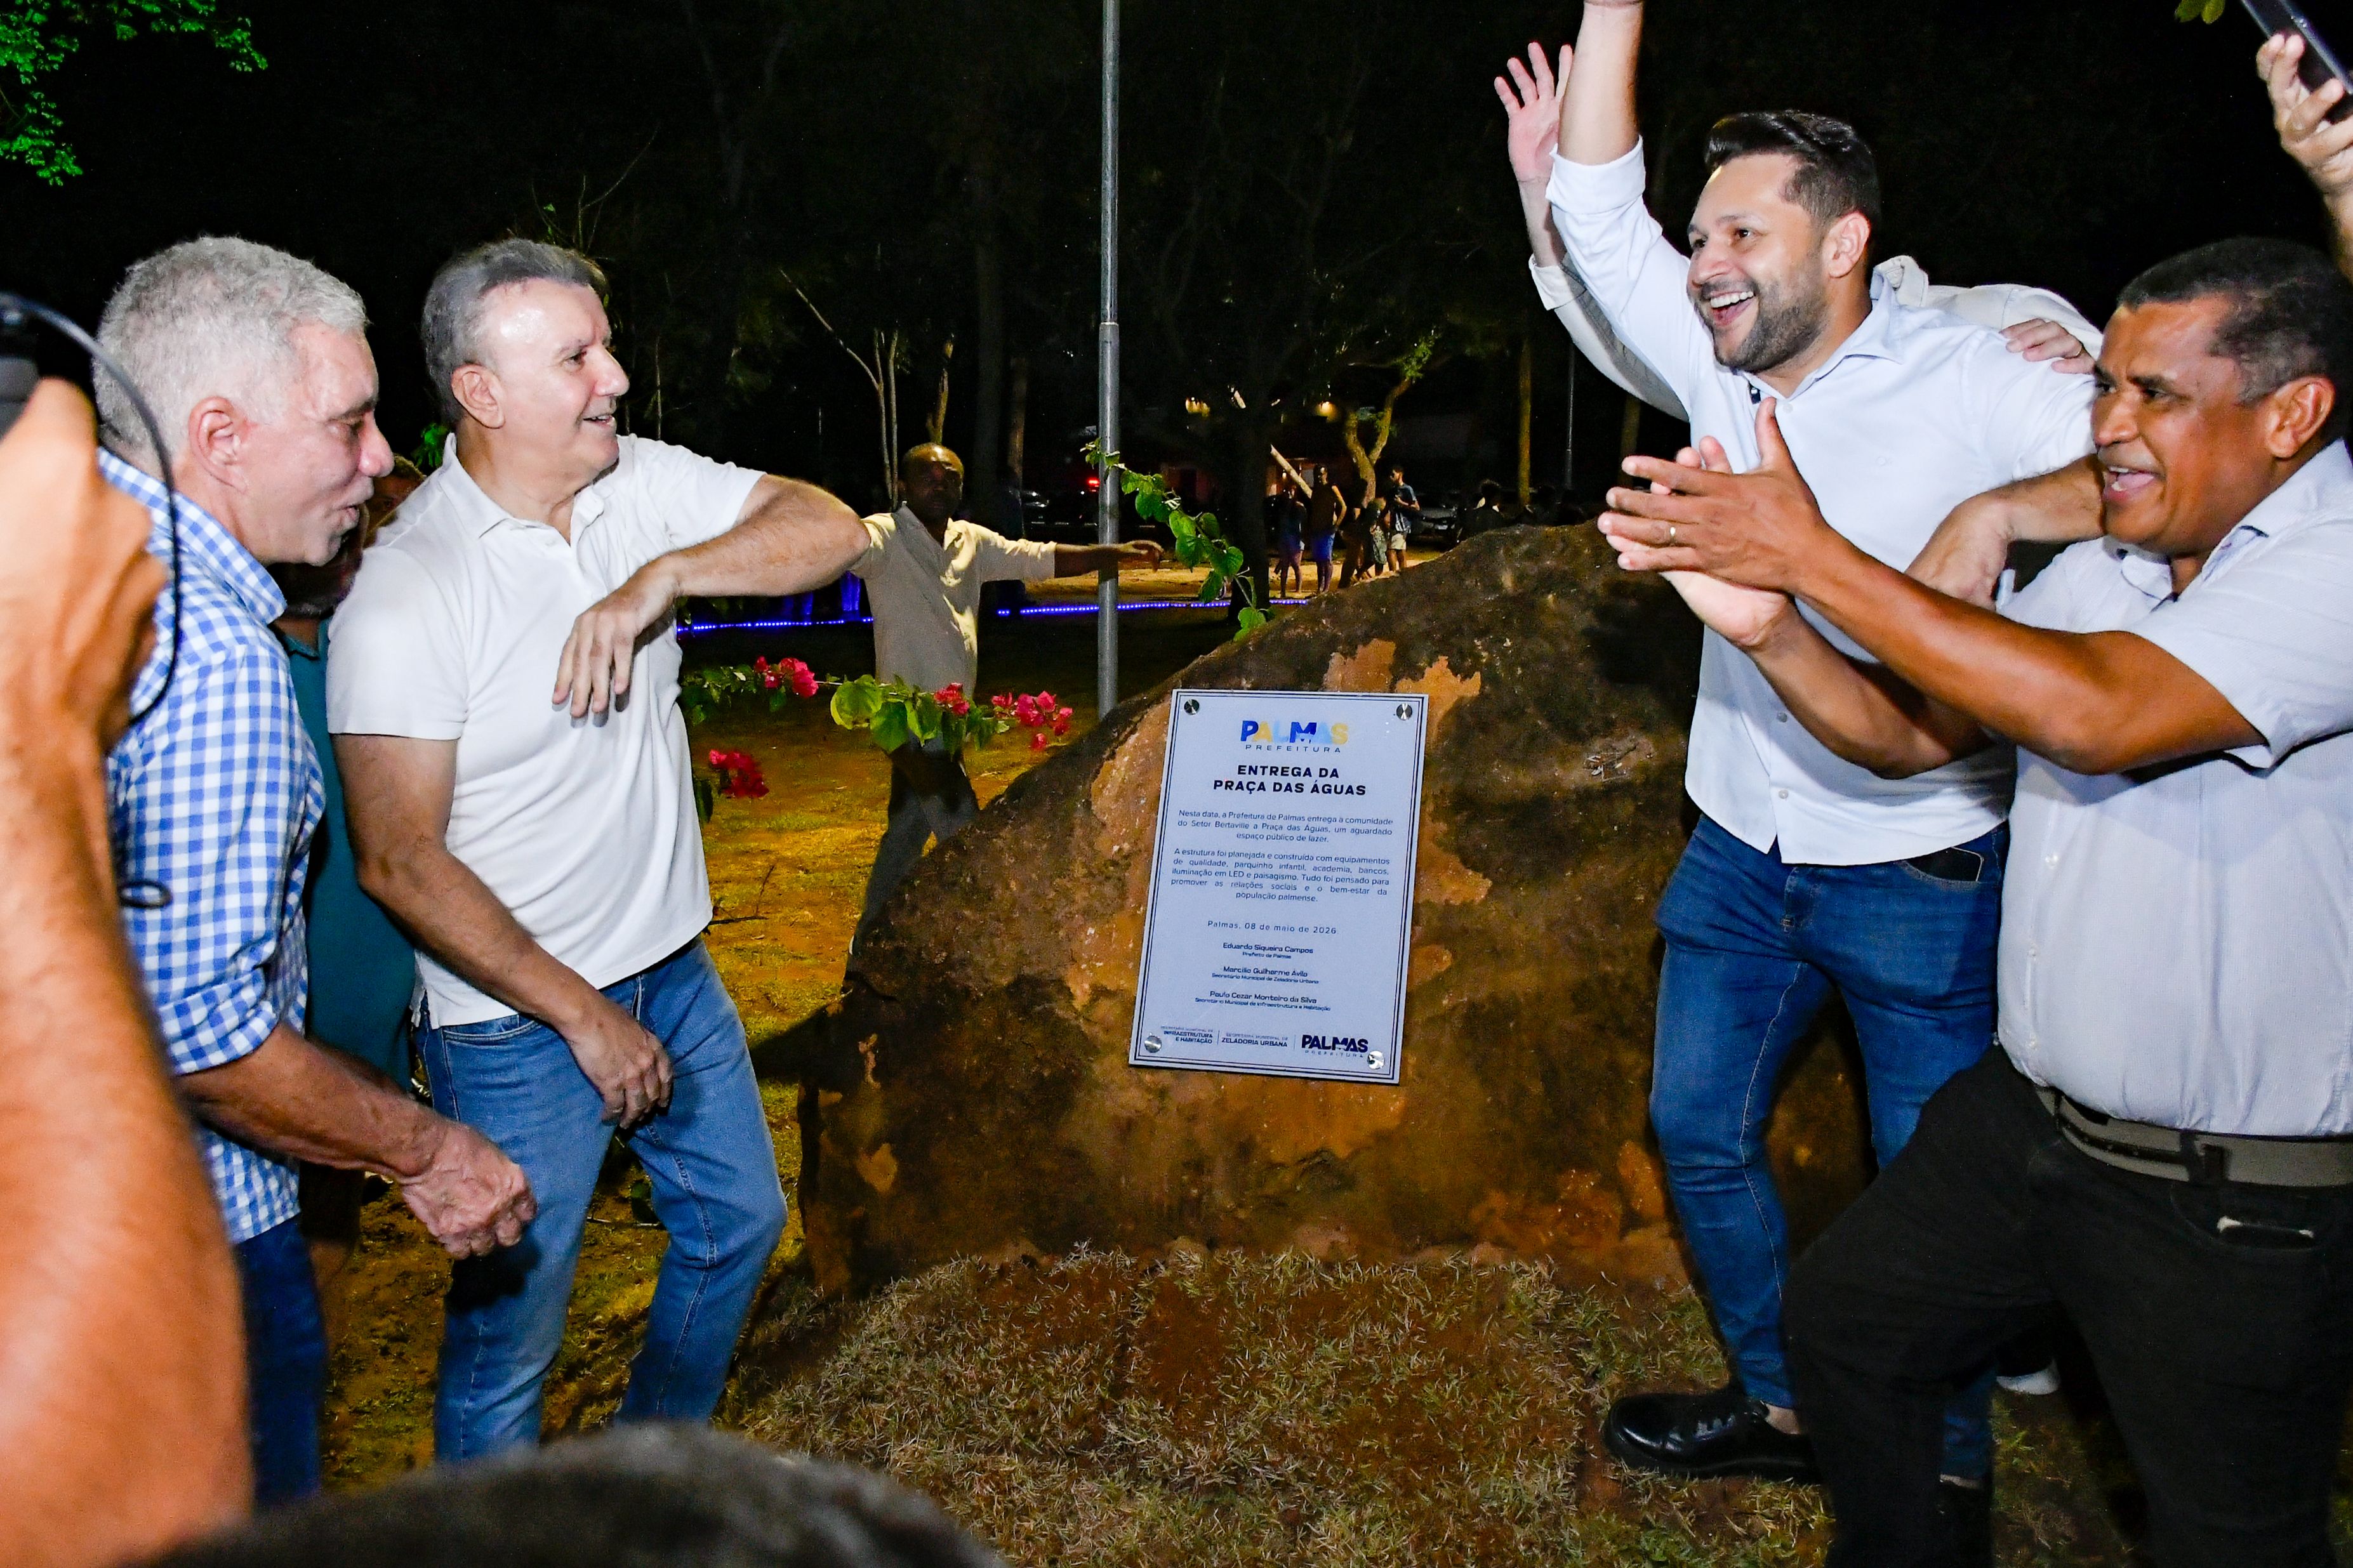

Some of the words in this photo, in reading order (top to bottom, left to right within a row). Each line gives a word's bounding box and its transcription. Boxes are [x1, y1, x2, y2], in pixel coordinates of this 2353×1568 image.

[1241, 720, 1348, 744] PALMAS
[1245, 744, 1340, 753] PREFEITURA
[1237, 765, 1312, 777] ENTREGA
[1318, 767, 1339, 778] DA
[1213, 779, 1266, 794] PRAÇA
[1272, 781, 1304, 793] DAS
[1309, 779, 1366, 796] ÁGUAS
[1228, 811, 1264, 819] Prefeitura
[1307, 815, 1337, 824] entrega
[1214, 820, 1249, 829] Bertaville
[1261, 822, 1283, 831] Praça
[1304, 823, 1330, 833] Águas,
[1228, 850, 1264, 859] planejada
[1334, 855, 1389, 864] equipamentos
[1172, 867, 1212, 877] iluminação
[1253, 872, 1298, 881] paisagismo.
[1301, 873, 1321, 881] Tudo
[1323, 874, 1333, 883] foi
[1231, 881, 1263, 889] relações
[1330, 885, 1370, 894] bem-estar
[1235, 892, 1276, 900] população
[1278, 893, 1318, 902] palmense.
[1313, 926, 1336, 934] 2026
[1223, 942, 1252, 950] Eduardo
[1254, 944, 1283, 952] Siqueira
[1284, 945, 1313, 954] Campos
[1252, 967, 1290, 976] Guilherme
[1254, 993, 1288, 1001] Monteiro
[1301, 1034, 1369, 1053] PALMAS
